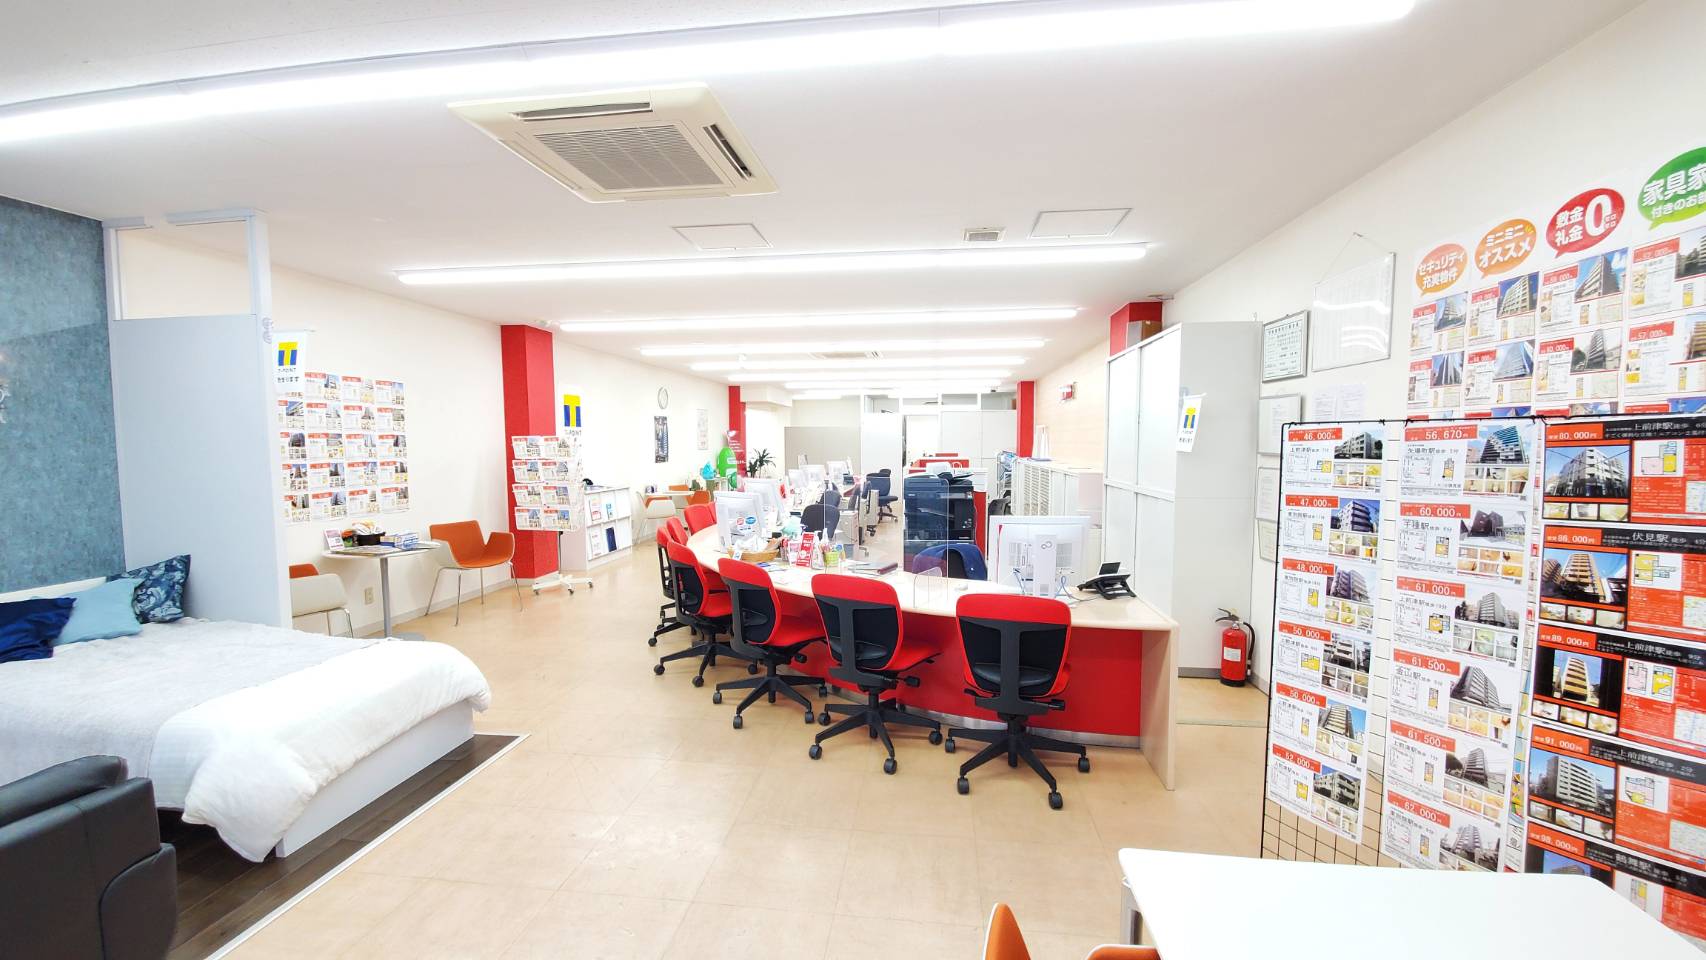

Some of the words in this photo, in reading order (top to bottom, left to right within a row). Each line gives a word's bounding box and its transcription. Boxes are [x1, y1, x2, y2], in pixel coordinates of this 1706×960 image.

[1556, 206, 1584, 229] 敷金
[1585, 194, 1612, 237] 0
[1486, 224, 1524, 247] ミニミニ
[1554, 224, 1584, 247] 礼金
[1418, 251, 1465, 275] セキュリティ
[1479, 237, 1531, 268] オススメ
